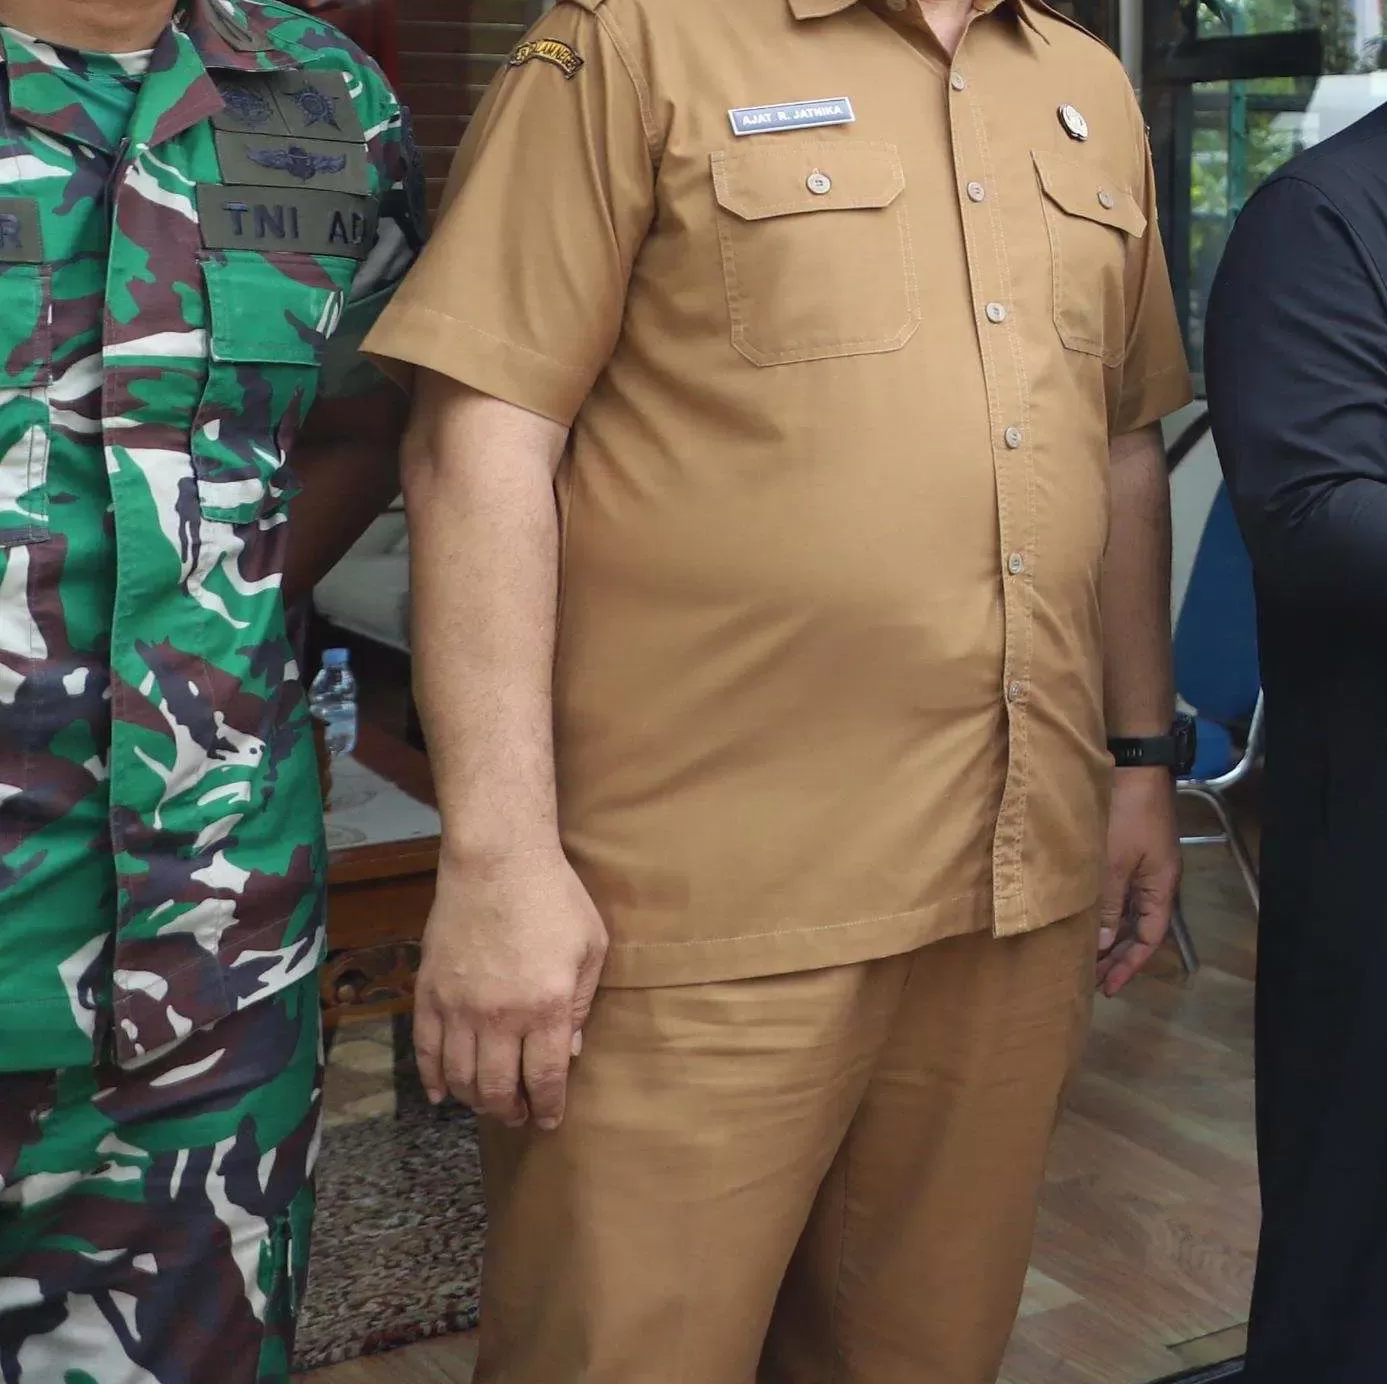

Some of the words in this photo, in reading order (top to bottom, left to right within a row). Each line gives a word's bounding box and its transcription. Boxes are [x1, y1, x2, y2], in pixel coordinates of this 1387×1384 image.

[742, 113, 772, 126] AJAT
[776, 111, 791, 121] R.
[793, 105, 843, 120] JATNIKA
[222, 201, 300, 240] TNI
